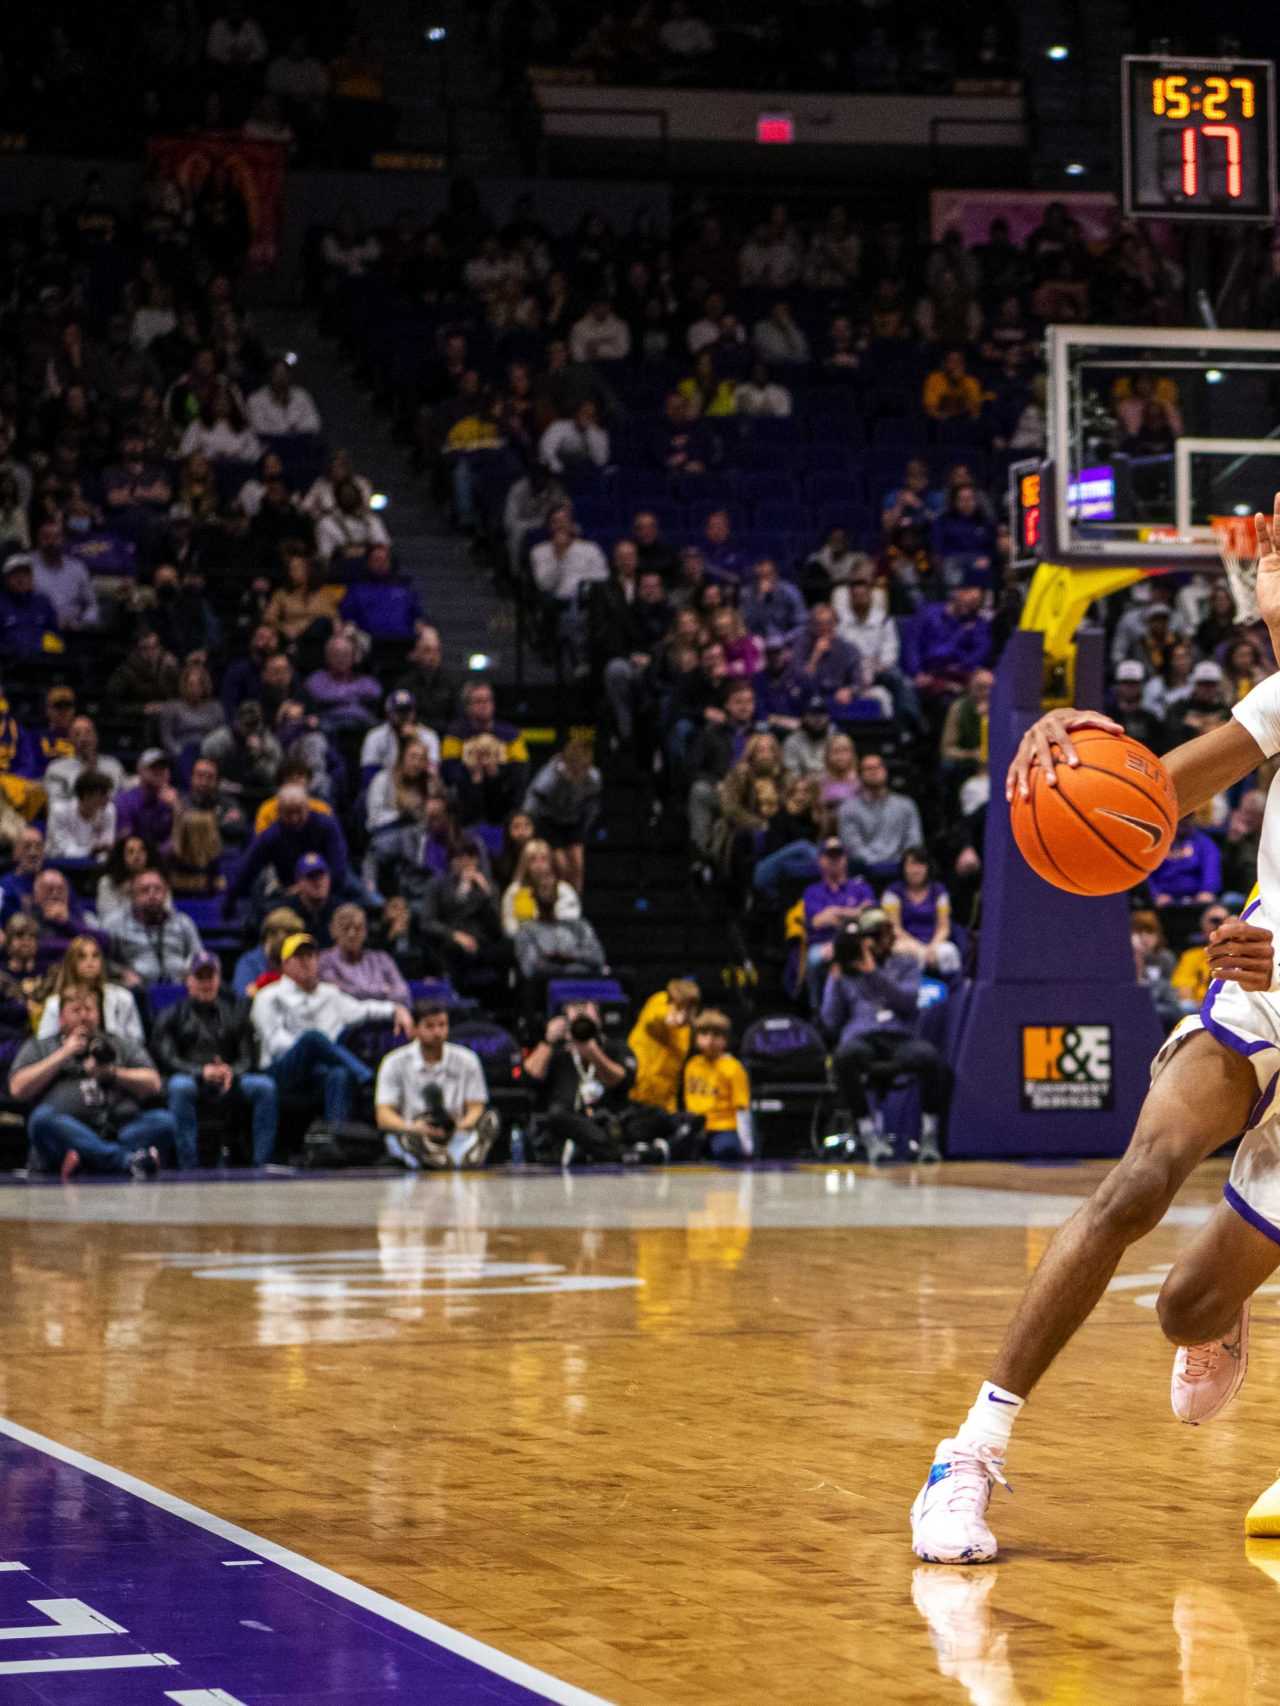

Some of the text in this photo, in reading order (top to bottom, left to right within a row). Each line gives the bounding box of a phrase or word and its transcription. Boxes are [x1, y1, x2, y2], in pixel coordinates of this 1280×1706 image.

[1153, 75, 1255, 120] 15:27
[1182, 126, 1242, 197] 17
[1023, 1025, 1110, 1080] H&E
